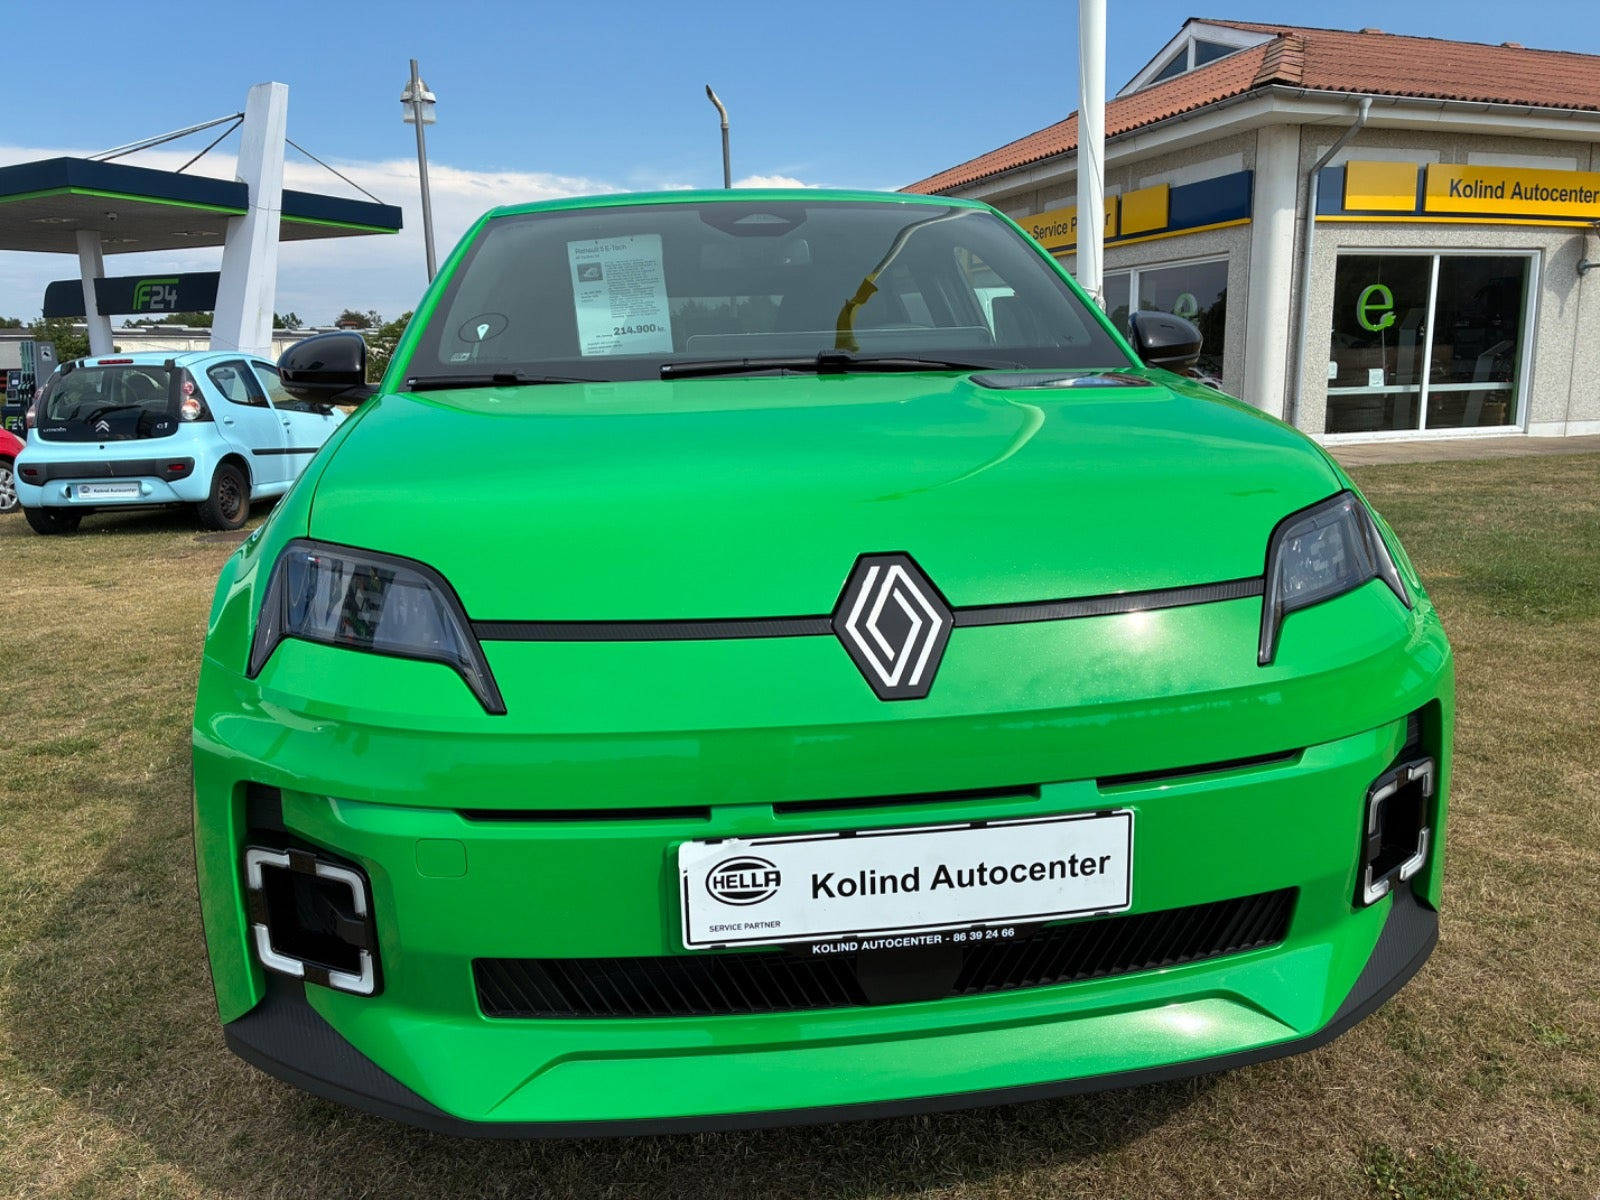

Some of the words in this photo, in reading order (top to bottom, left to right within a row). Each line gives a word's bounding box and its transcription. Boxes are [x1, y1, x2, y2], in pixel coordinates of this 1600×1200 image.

[1450, 178, 1505, 199] Kolind
[1511, 181, 1599, 204] Autocenter
[1033, 221, 1068, 240] Service
[133, 278, 179, 310] F24
[613, 324, 656, 336] 214.900
[713, 870, 782, 890] HELLA
[811, 865, 920, 900] Kolind
[930, 852, 1112, 891] Autocenter
[709, 923, 743, 933] SERVICE
[744, 920, 781, 931] PARTNER
[812, 941, 858, 955] KOLIND
[861, 934, 943, 951] AUTOCENTER
[953, 933, 966, 942] 86
[969, 931, 983, 941] 39
[985, 929, 999, 939] 24
[1001, 927, 1015, 937] 66
